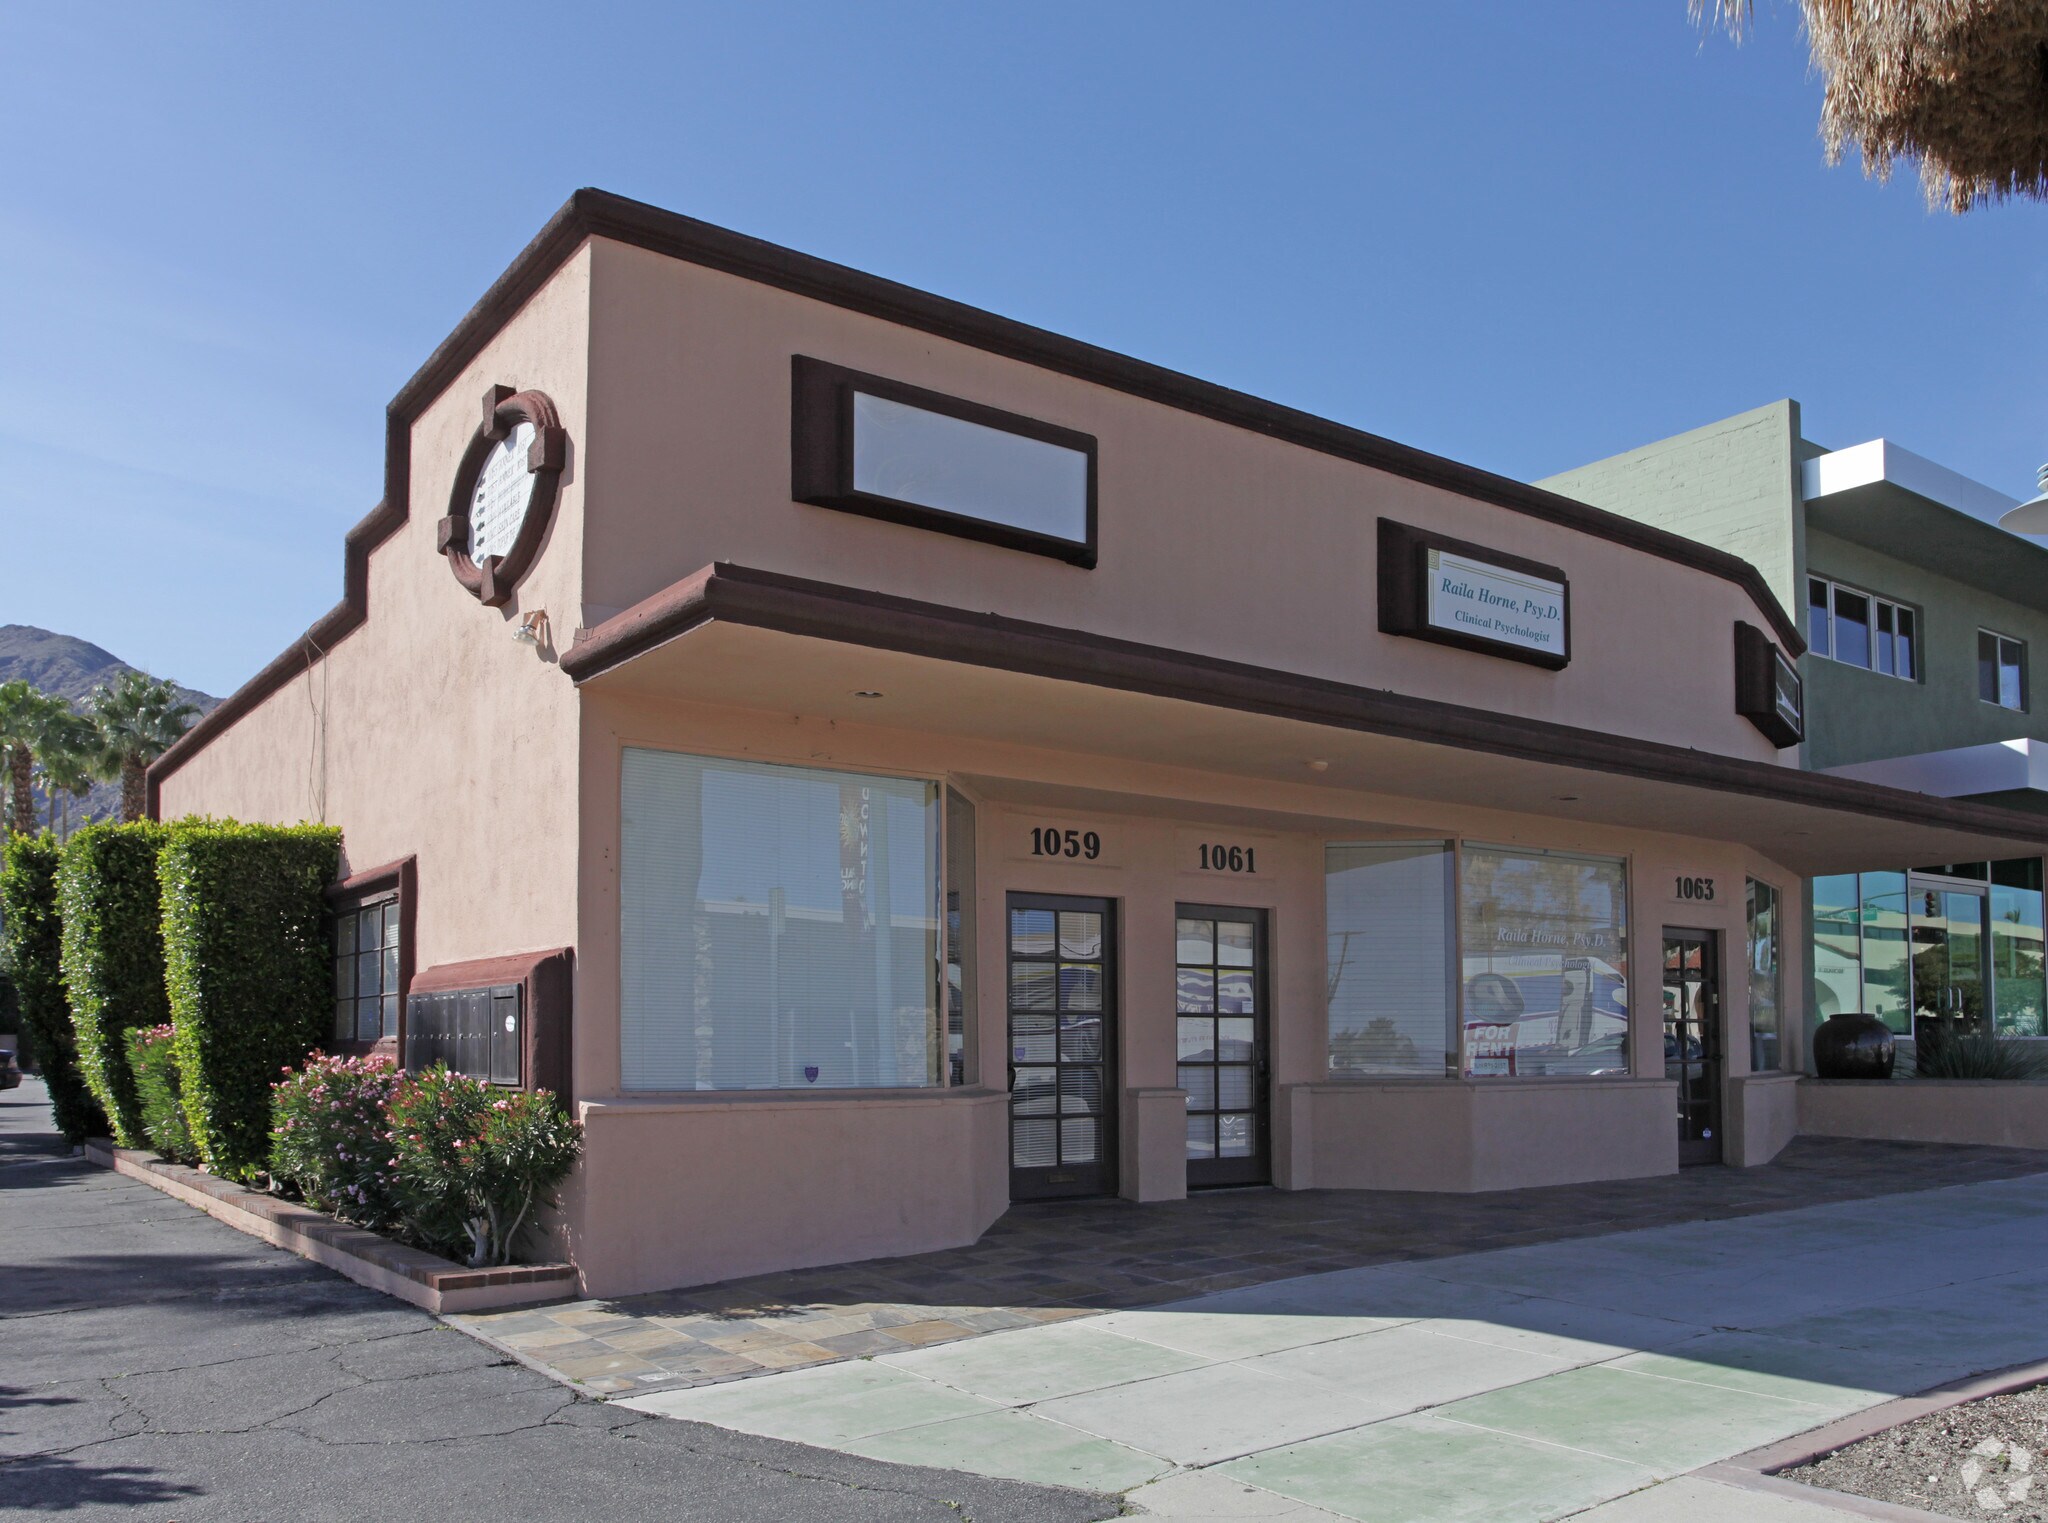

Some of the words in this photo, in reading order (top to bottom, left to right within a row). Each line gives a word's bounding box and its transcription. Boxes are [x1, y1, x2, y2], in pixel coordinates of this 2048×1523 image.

[1441, 577, 1474, 599] Raila
[1478, 588, 1519, 614] Horne,
[1523, 599, 1560, 621] Psy.D.
[1455, 610, 1491, 629] Clinical
[1494, 620, 1550, 643] Psychologist
[1030, 827, 1101, 860] 1059
[1198, 843, 1256, 873] 1061
[1675, 876, 1715, 900] 1063
[1497, 927, 1527, 943] Raila
[1531, 929, 1569, 947] Horne,
[1573, 932, 1606, 949] Psy.D.
[1474, 1025, 1510, 1040] FOR
[1466, 1042, 1514, 1057] RENT
